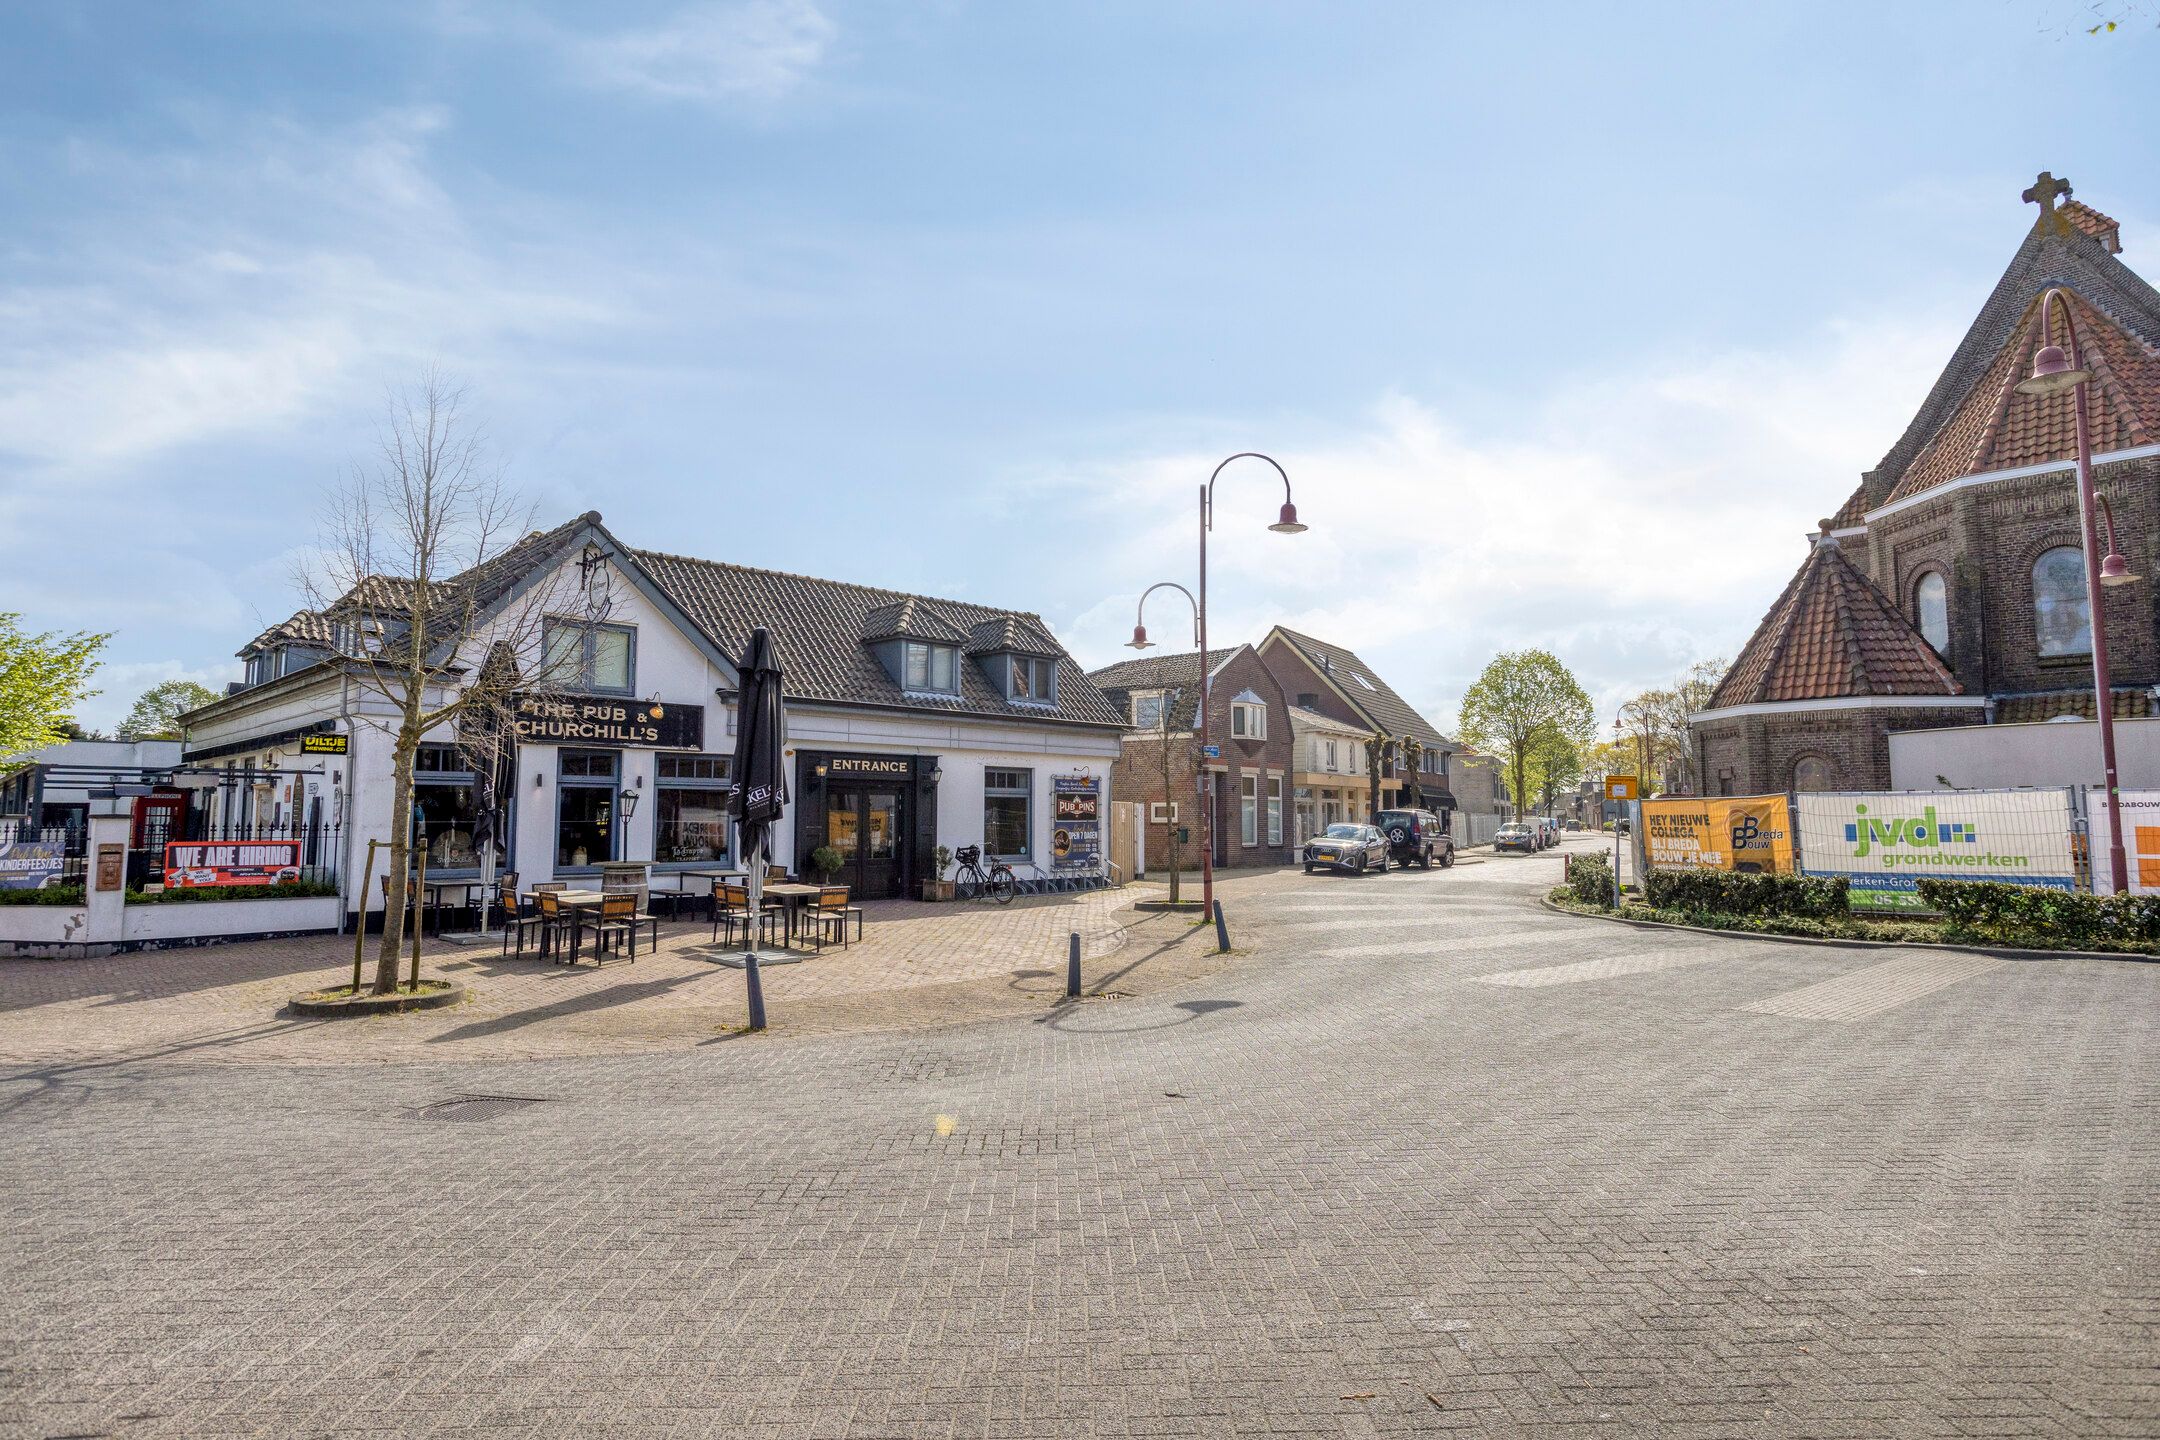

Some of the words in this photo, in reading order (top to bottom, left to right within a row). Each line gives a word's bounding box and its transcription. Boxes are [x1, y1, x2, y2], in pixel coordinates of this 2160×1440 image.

[533, 702, 576, 718] THE
[583, 705, 627, 722] PUB
[636, 712, 648, 723] &
[514, 720, 659, 742] CHURCHILL'S
[305, 736, 347, 747] UILTJE
[832, 759, 908, 772] ENTRANCE
[1059, 801, 1076, 812] PUB
[1079, 801, 1095, 812] PINS
[1649, 814, 1669, 825] HEY
[1670, 814, 1711, 826] NIEUWE
[1650, 826, 1699, 839] COLLEGA,
[1743, 816, 1784, 840] Breda
[1853, 803, 1940, 858] jvd
[1651, 838, 1666, 850] BIJ
[1667, 838, 1701, 851] BREDA
[1732, 827, 1770, 850] Bouw
[175, 846, 202, 867] WE
[204, 846, 236, 867] ARE
[238, 845, 292, 866] HIRING
[1652, 850, 1684, 863] BOUW
[1686, 852, 1698, 863] JE
[1700, 851, 1723, 864] MEE
[1882, 851, 2029, 868] grondwerken
[0, 858, 64, 871] KINDERFEESTJES
